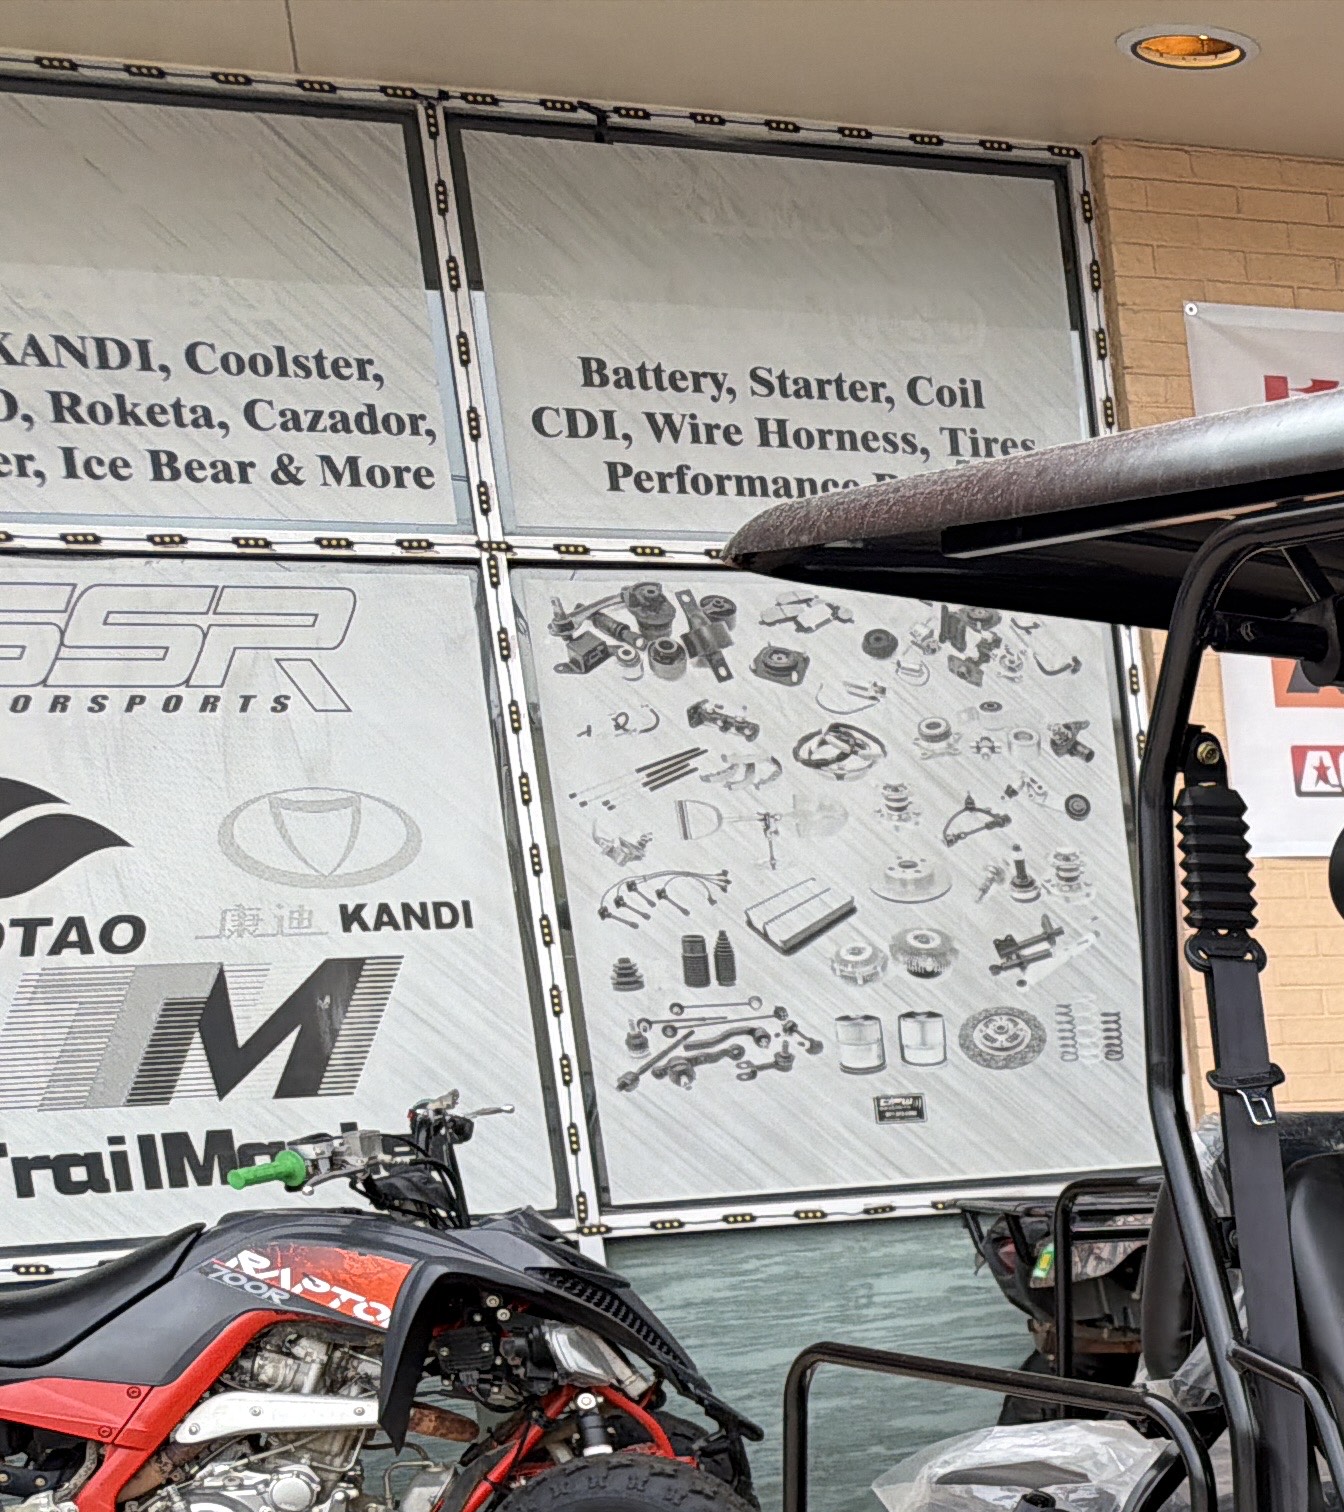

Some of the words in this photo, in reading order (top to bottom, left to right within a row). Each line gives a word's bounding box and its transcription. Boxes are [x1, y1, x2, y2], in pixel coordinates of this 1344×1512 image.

[185, 340, 385, 389] Coolster,
[577, 355, 737, 403] Battery,
[748, 365, 895, 411] Starter,
[905, 374, 986, 410] Coil
[45, 388, 231, 437] Roketa,
[242, 396, 437, 445] Cazador,
[531, 404, 633, 446] CDI,
[641, 411, 744, 446] Wire
[755, 417, 931, 464] Horness,
[57, 445, 133, 482] Ice
[146, 449, 257, 487] Bear
[270, 454, 306, 486] &
[315, 453, 438, 490] More
[0, 914, 147, 957] TAO
[339, 900, 474, 934] KANDI
[205, 1264, 291, 1306] 700R
[225, 1249, 393, 1329] RAPTO
